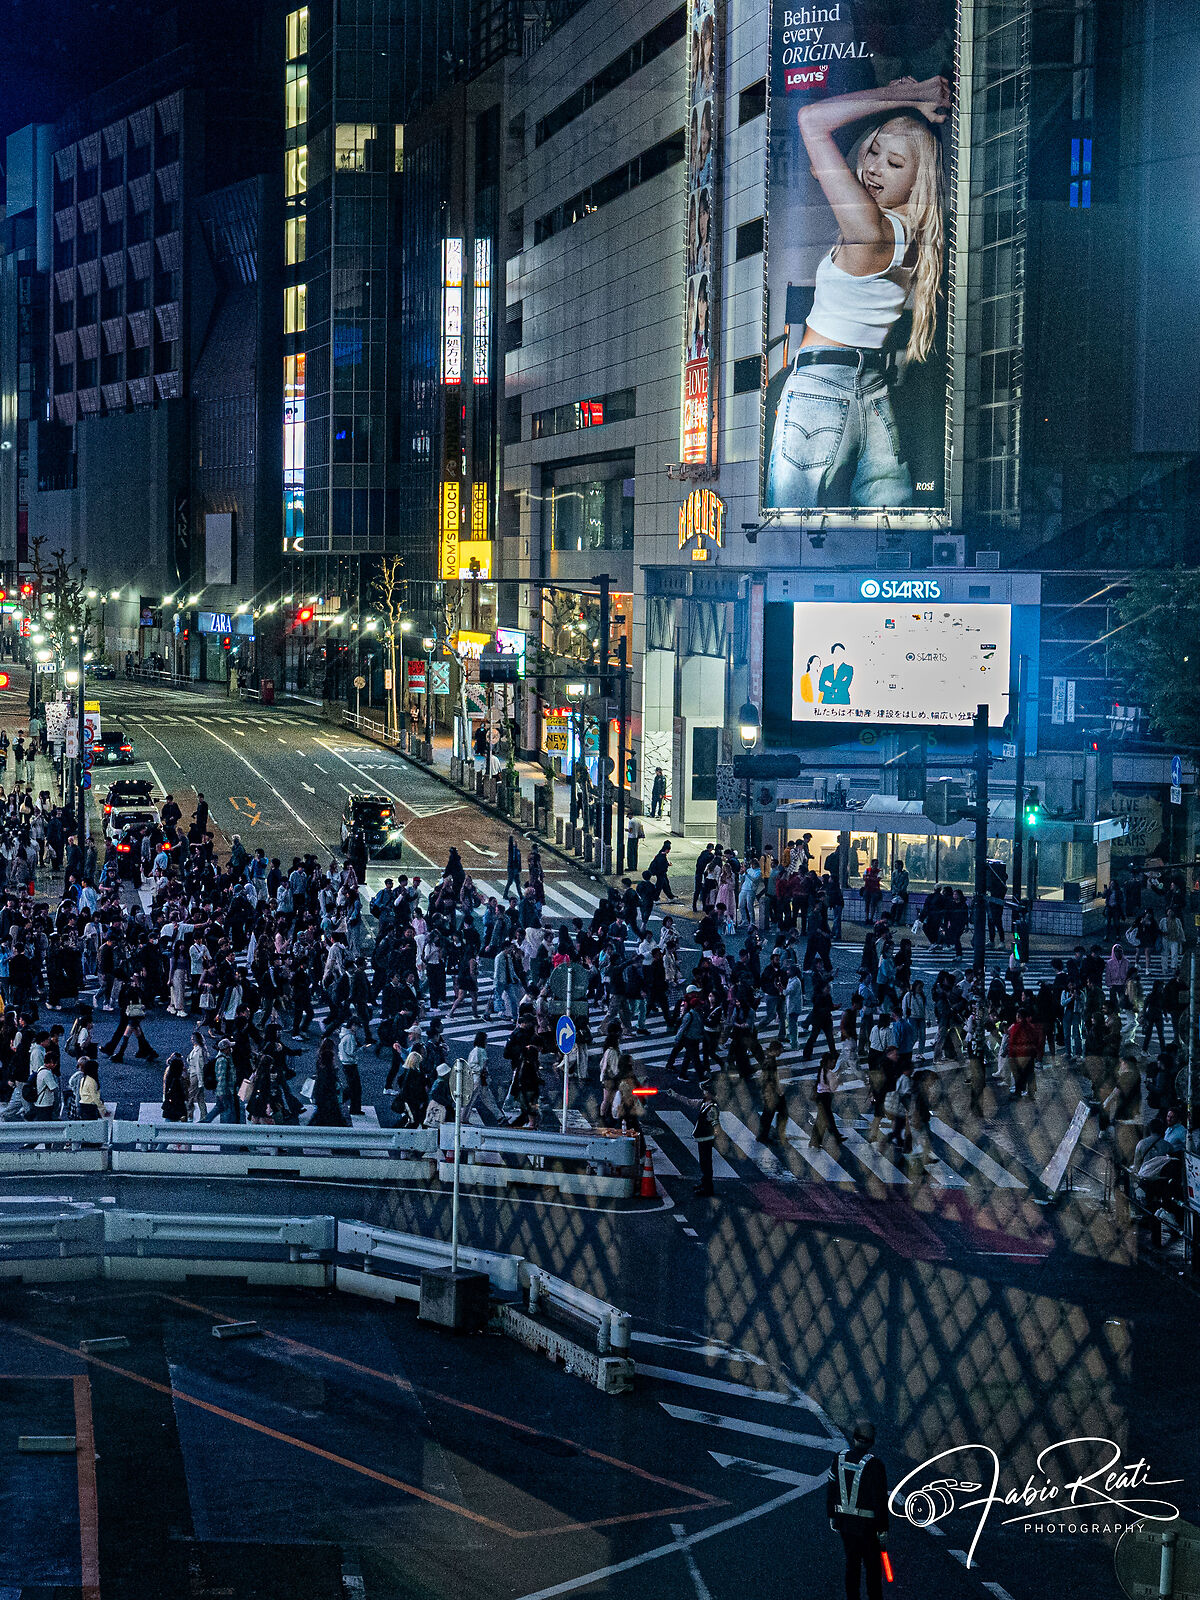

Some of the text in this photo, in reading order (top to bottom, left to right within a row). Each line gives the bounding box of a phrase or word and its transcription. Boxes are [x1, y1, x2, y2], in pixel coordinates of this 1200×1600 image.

[784, 4, 840, 27] Behind
[782, 27, 824, 44] every
[782, 41, 874, 65] ORIGINAL.
[447, 305, 459, 333] 内科
[446, 338, 460, 376] 処方せん
[915, 481, 935, 490] ROSÉ
[446, 482, 457, 576] MOM'S TOUCH
[678, 489, 724, 550] MAGNET
[211, 613, 232, 633] ZARA
[553, 743, 566, 751] 4.7
